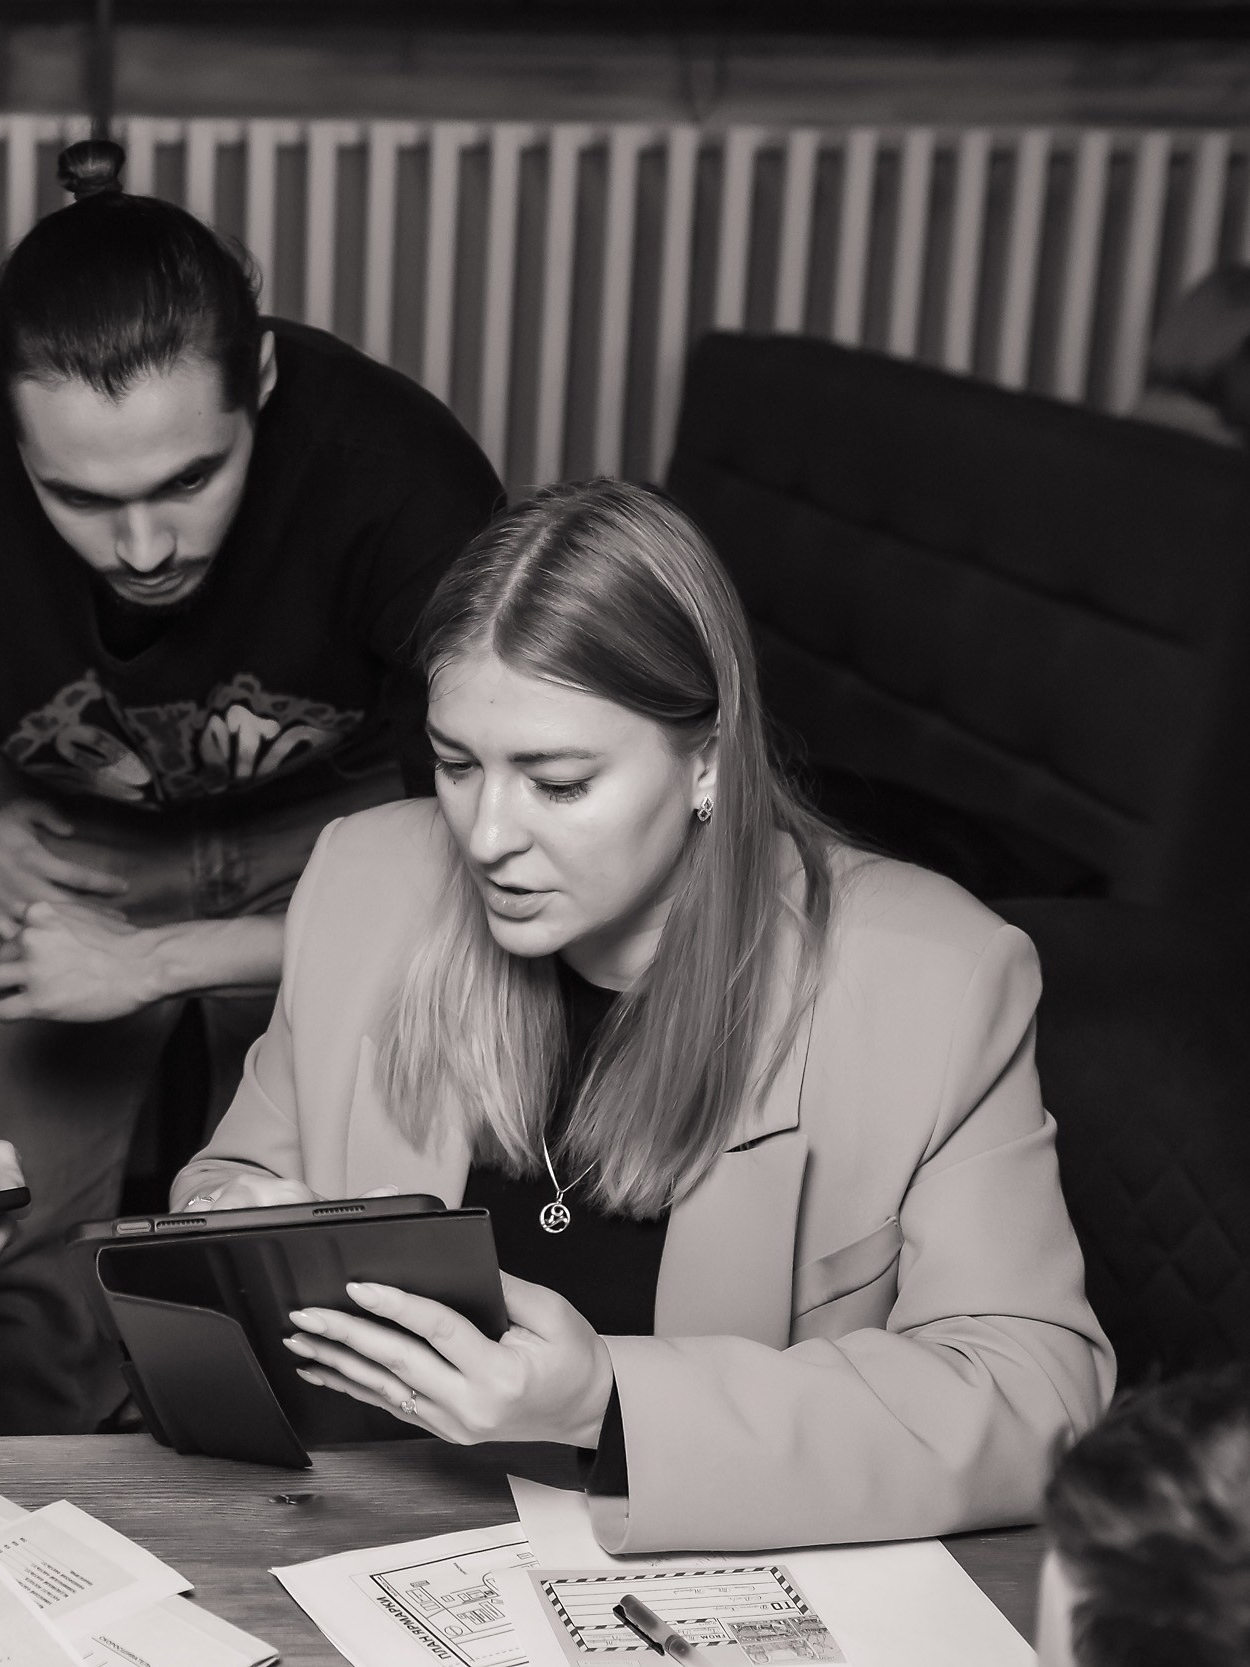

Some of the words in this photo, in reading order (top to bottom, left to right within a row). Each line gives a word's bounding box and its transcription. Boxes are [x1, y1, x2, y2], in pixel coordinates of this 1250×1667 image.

[770, 1601, 795, 1611] TO
[376, 1596, 424, 1637] ЯРМАРКИ
[699, 1632, 726, 1641] FROM
[419, 1634, 452, 1660] ПЛАН
